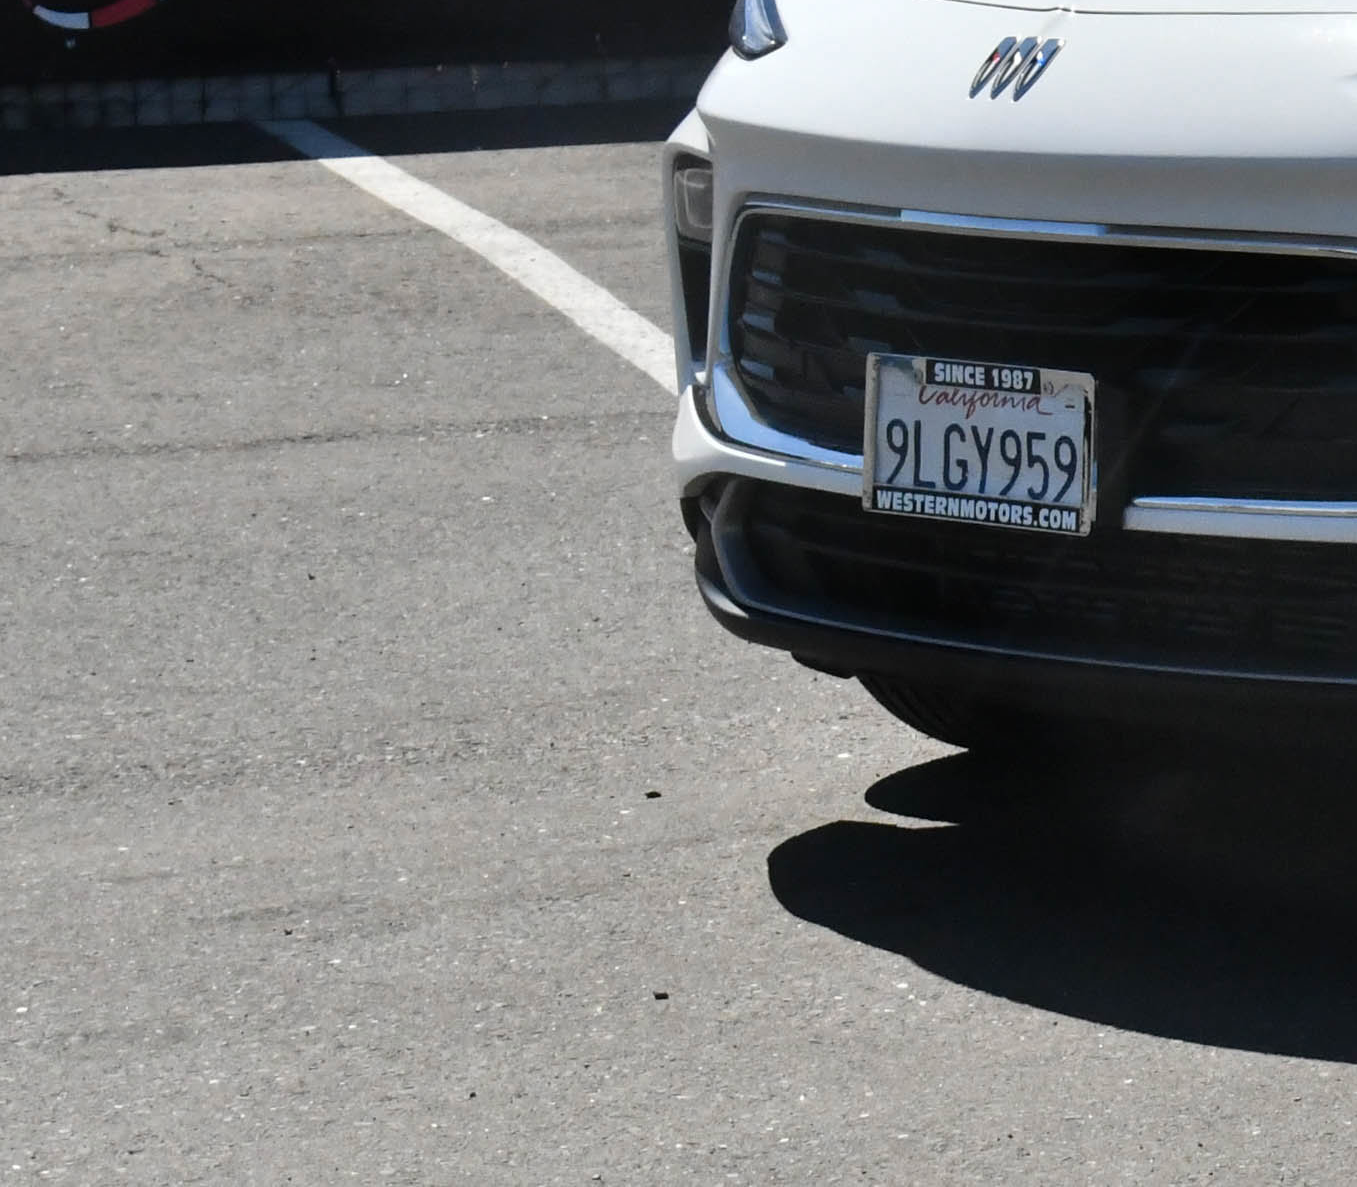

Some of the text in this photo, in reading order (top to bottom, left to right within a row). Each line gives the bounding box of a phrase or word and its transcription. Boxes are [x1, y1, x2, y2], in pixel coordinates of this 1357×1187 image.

[934, 362, 1034, 390] SINCE 1987
[886, 418, 1078, 502] 9LGY959
[876, 490, 1077, 531] WESTERNMOTORS.COM
